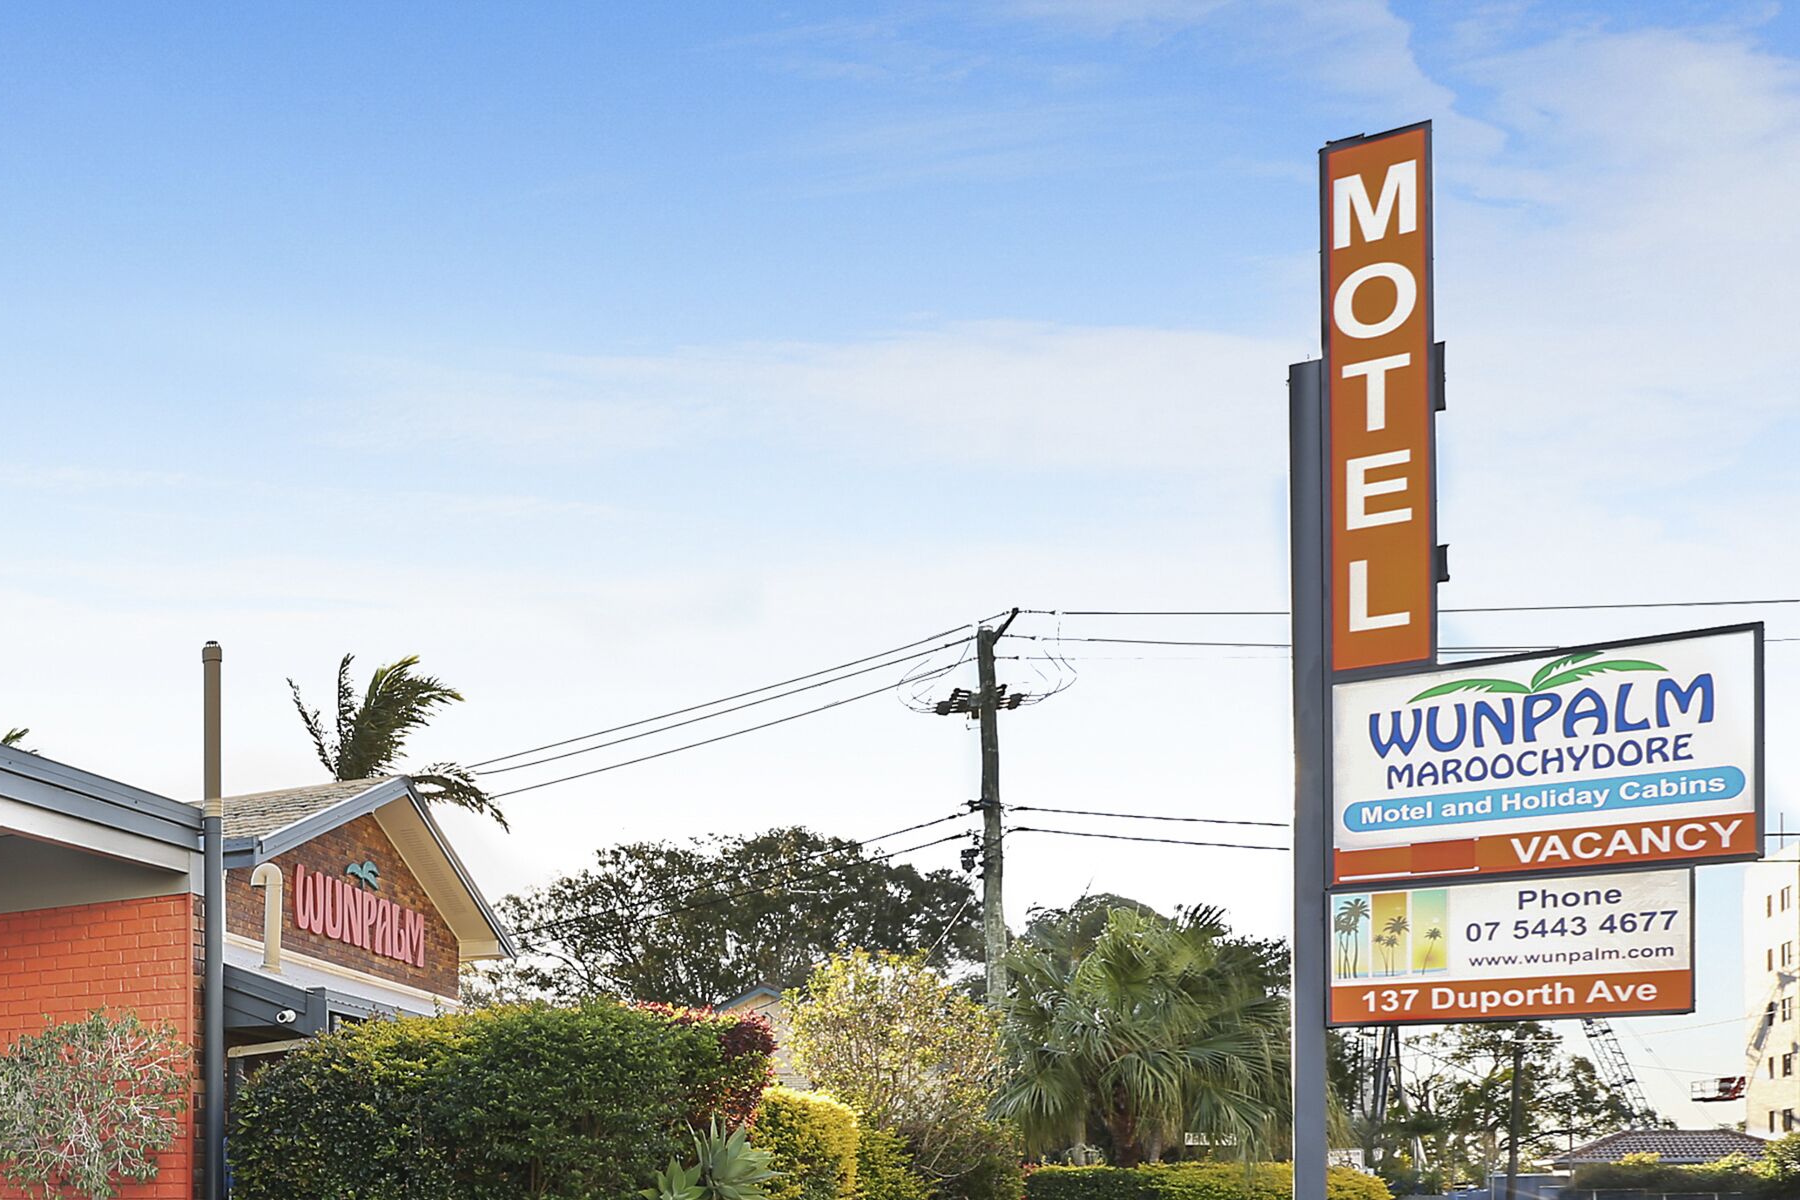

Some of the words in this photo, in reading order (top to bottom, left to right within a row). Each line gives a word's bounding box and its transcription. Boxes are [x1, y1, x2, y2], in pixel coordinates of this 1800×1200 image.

[1333, 159, 1417, 633] MOTEL
[1368, 672, 1715, 759] WUNPALM
[1386, 733, 1694, 790] MAROOCHYDORE
[1360, 801, 1433, 825] Motel
[1441, 797, 1492, 818] and
[1501, 783, 1612, 814] Holiday
[1618, 774, 1726, 801] Cabins
[1510, 819, 1744, 864] VACANCY
[293, 863, 425, 968] WUNPALM
[1517, 887, 1623, 911] Phone
[1465, 922, 1501, 942] 07
[1512, 916, 1588, 940] 5443
[1599, 909, 1679, 935] 4677
[1468, 944, 1675, 967] www.wunpalm.com
[1361, 989, 1419, 1013] 137
[1431, 982, 1575, 1013] Duporth
[1586, 979, 1658, 1004] Ave
